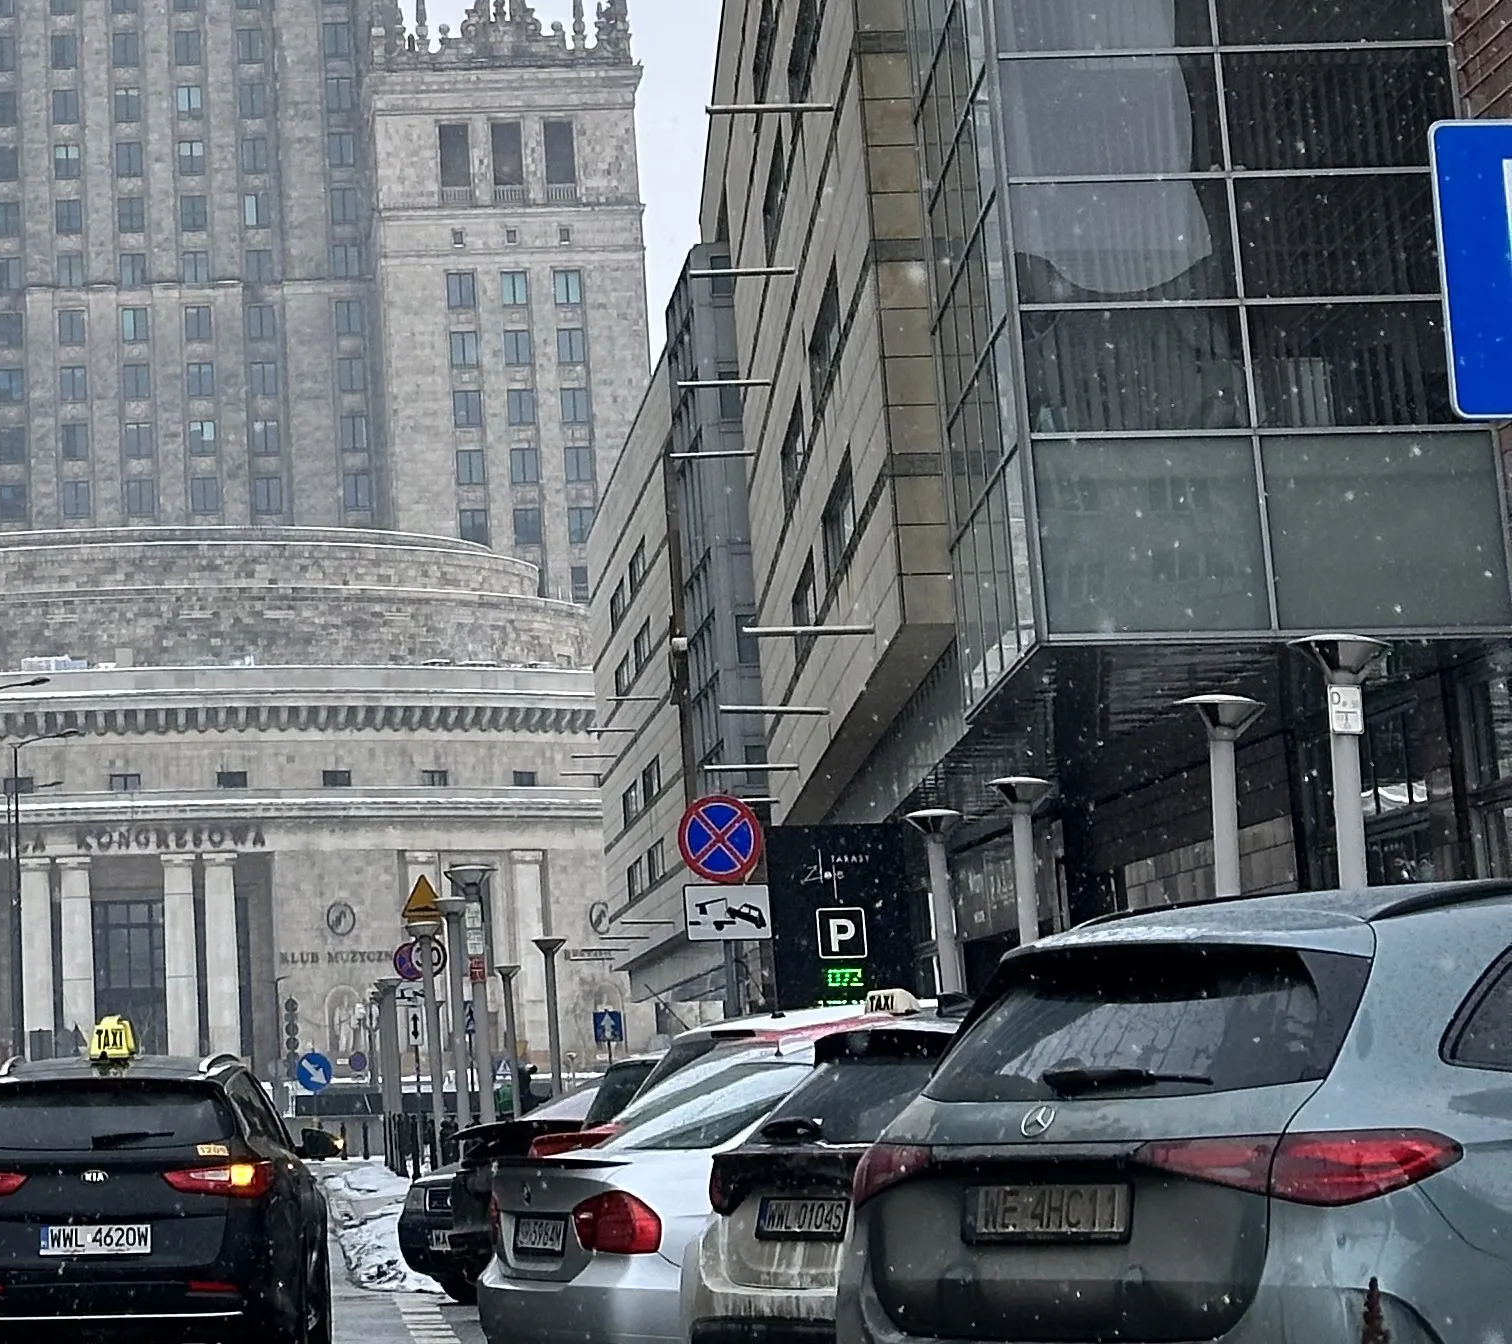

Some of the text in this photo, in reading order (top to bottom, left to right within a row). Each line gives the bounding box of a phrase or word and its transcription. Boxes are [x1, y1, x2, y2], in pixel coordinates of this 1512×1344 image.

[76, 825, 266, 852] KONGRESOWA
[828, 918, 856, 952] P
[327, 950, 394, 965] MUZYCZN
[868, 994, 895, 1012] TAXI
[95, 1028, 123, 1050] TAXI
[84, 1172, 105, 1182] KIA
[50, 1226, 149, 1249] WWL 4620W
